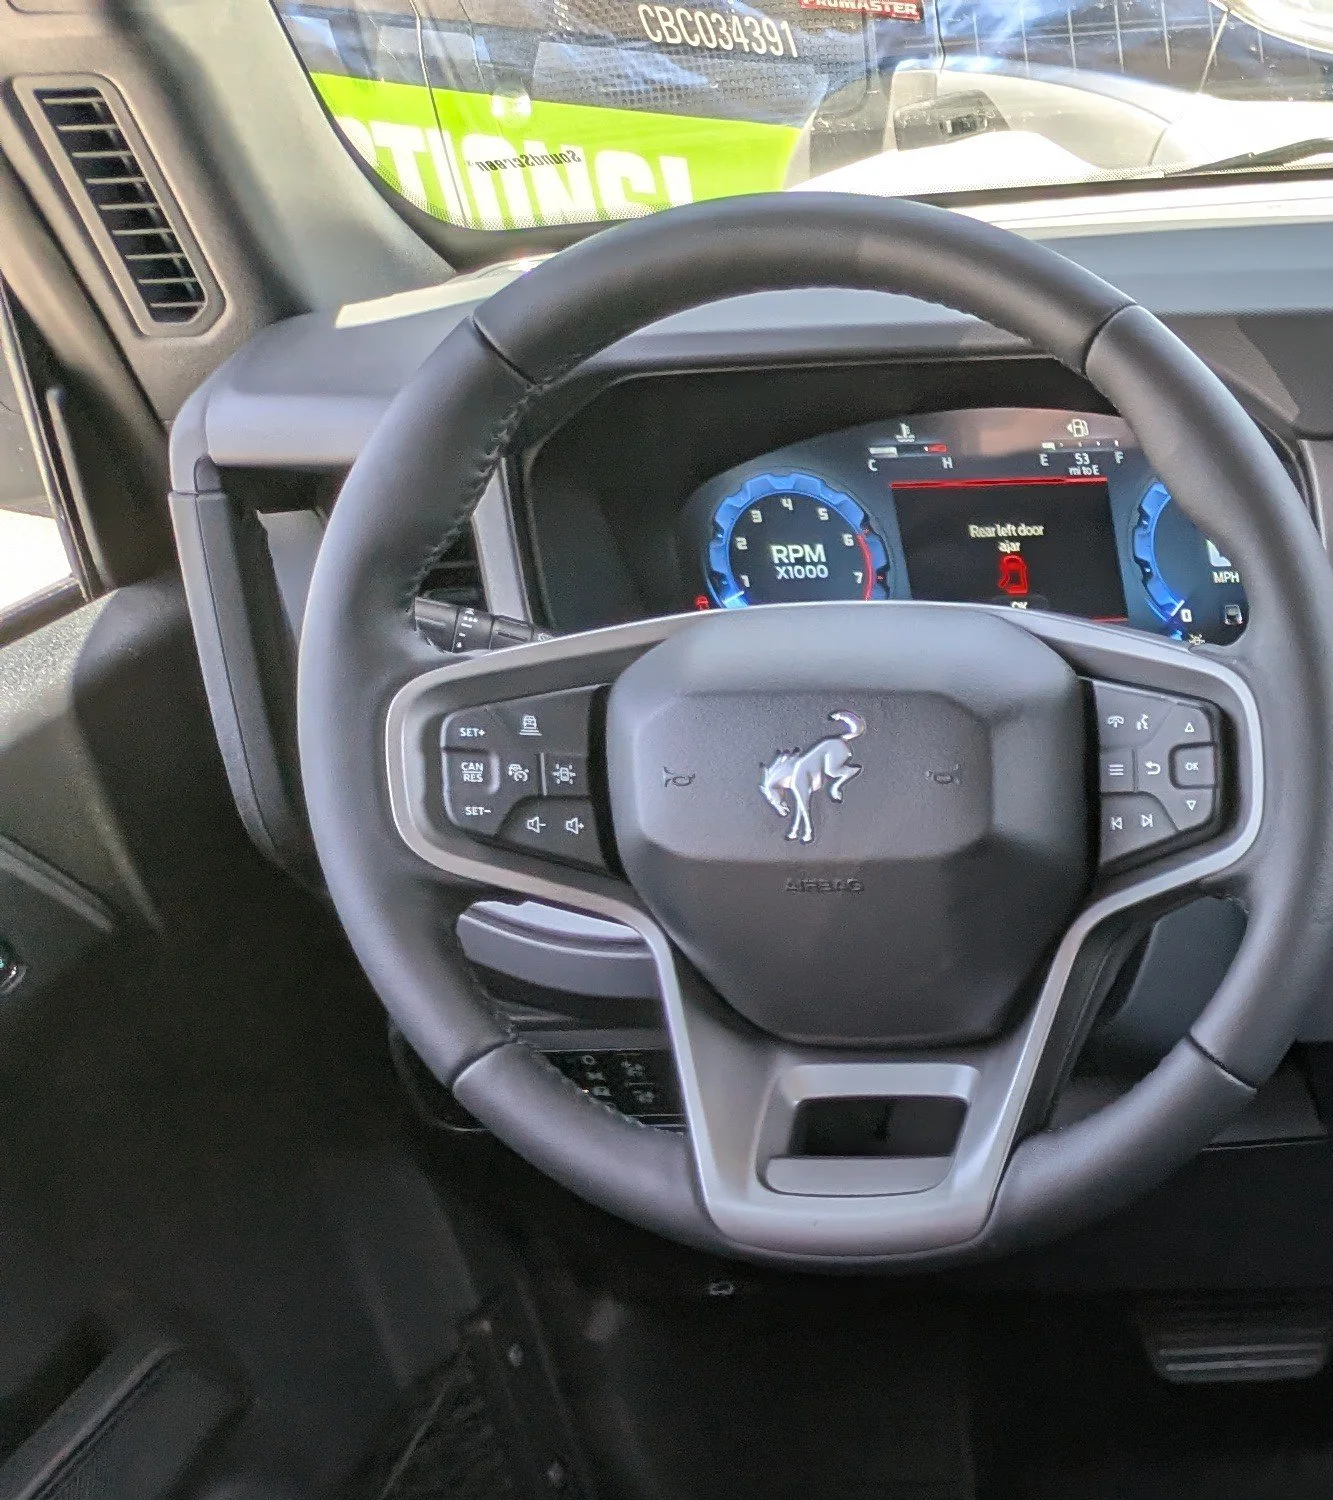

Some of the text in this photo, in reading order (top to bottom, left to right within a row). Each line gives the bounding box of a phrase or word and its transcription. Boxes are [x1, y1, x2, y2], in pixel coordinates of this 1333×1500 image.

[637, 4, 798, 58] CBC034391
[942, 457, 953, 469] H
[1039, 453, 1049, 467] E
[1114, 451, 1124, 464] F
[867, 459, 878, 472] C
[781, 498, 794, 511] 4
[751, 510, 763, 523] 3
[817, 508, 829, 521] 5
[968, 523, 1044, 538] Rear left door
[735, 537, 748, 550] 2
[842, 533, 854, 547] 6
[998, 540, 1021, 553] ajar
[770, 543, 827, 564] RPM
[775, 565, 828, 580] X1000
[853, 571, 863, 584] 7
[1212, 571, 1240, 584] MPH
[460, 727, 485, 737] SET+
[461, 762, 484, 772] CAN
[1185, 762, 1200, 771] OK
[463, 773, 484, 783] RES
[465, 807, 491, 816] SET-
